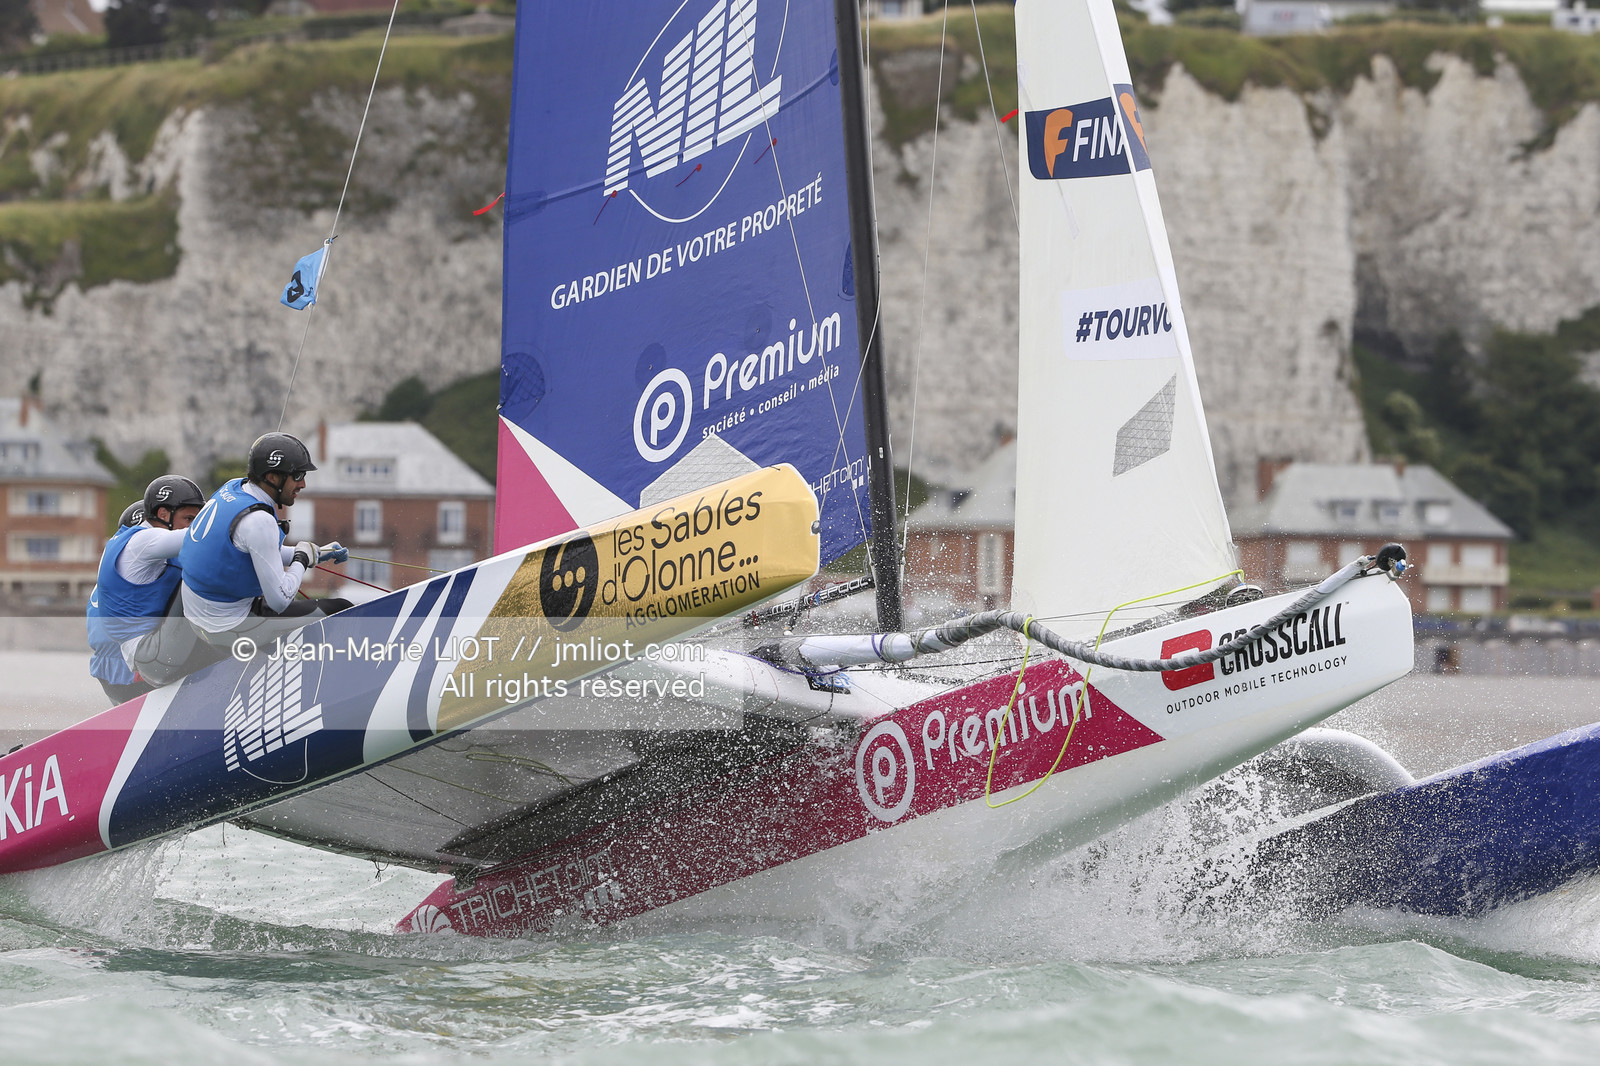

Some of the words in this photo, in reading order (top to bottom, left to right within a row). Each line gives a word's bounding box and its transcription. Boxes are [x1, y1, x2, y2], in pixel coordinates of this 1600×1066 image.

[550, 258, 642, 310] GARDIEN
[646, 248, 673, 280] DE
[676, 222, 737, 268] VOTRE
[740, 171, 823, 243] PROPRETÉ
[703, 311, 841, 410] Premium
[702, 406, 746, 439] société
[758, 385, 798, 414] conseil
[808, 365, 840, 391] média
[613, 522, 646, 558] les
[650, 489, 763, 549] Sables
[625, 571, 761, 630] AGGLOMÉRATION
[1218, 602, 1347, 676] CROSSCALL
[1166, 690, 1220, 714] OUTDOOR
[1224, 677, 1266, 697] MOBILE
[1271, 655, 1348, 684] TECHNOLOGY
[922, 680, 1093, 771] Premium
